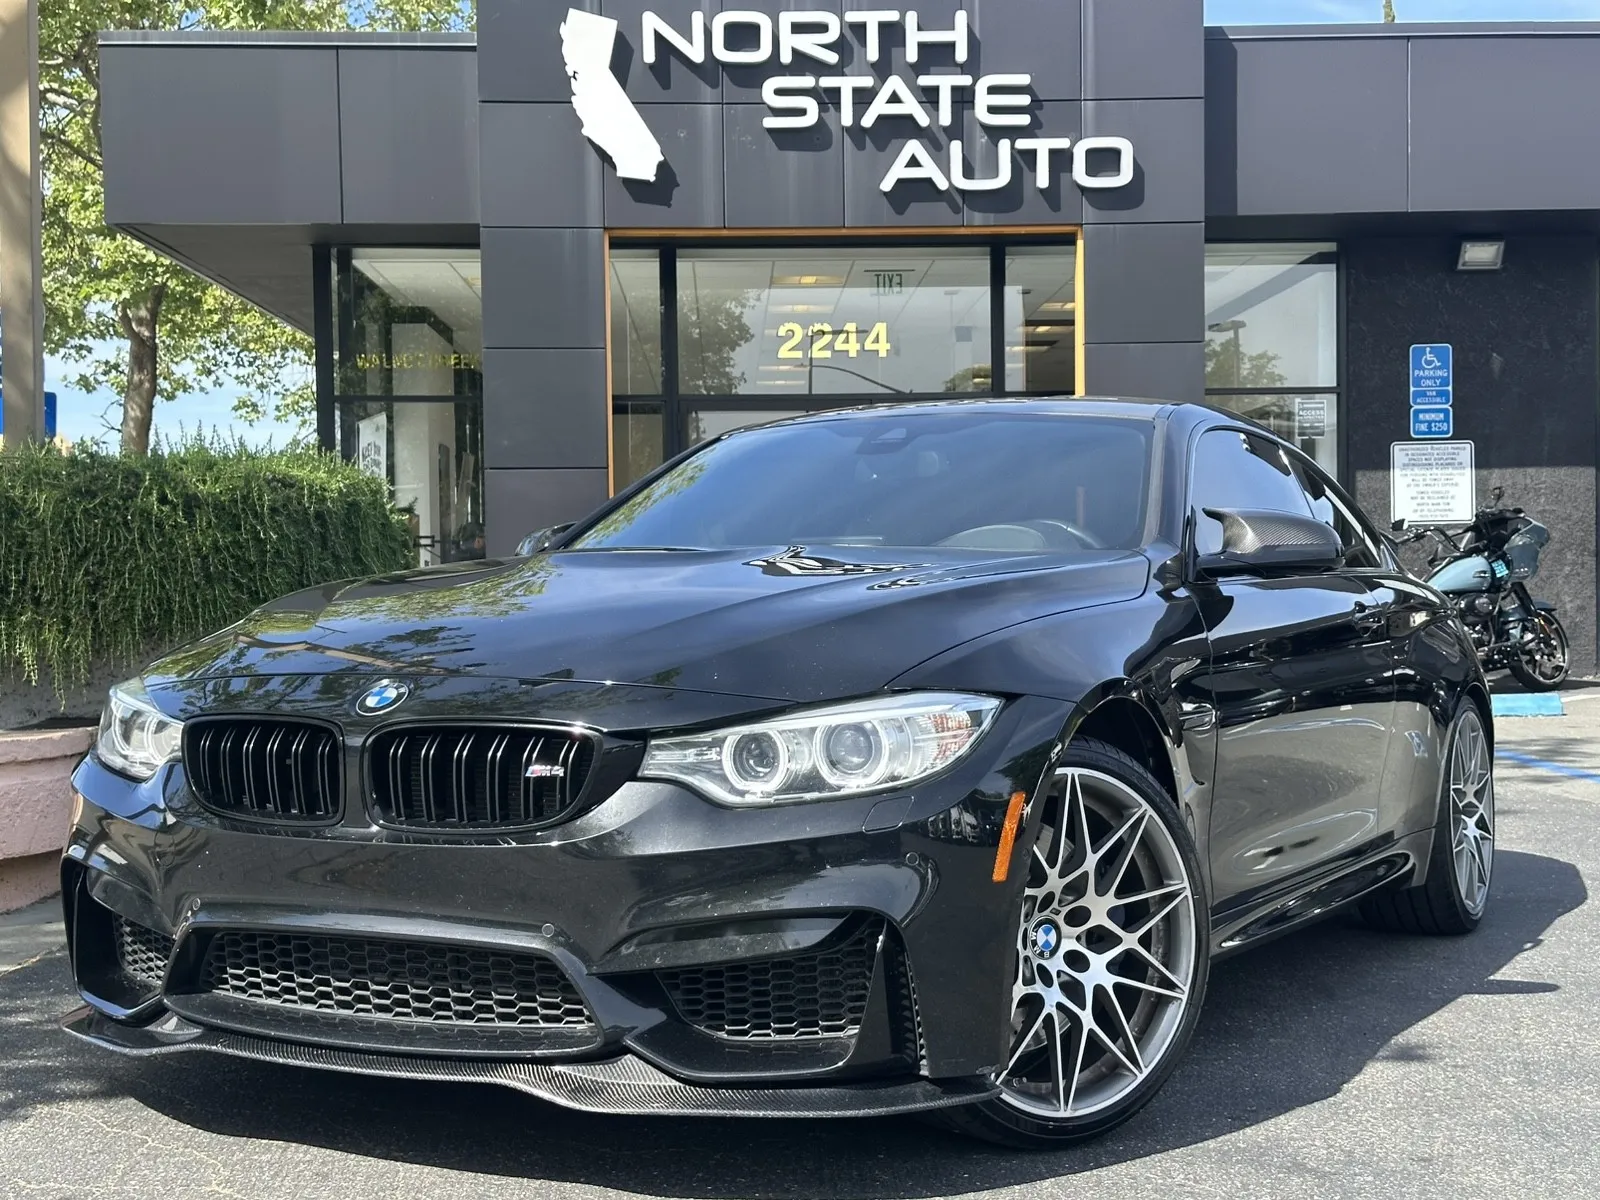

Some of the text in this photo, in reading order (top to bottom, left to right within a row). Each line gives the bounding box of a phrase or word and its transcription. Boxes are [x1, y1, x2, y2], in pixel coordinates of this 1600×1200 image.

[641, 9, 968, 65] NORTH
[761, 73, 1032, 129] STATE
[879, 136, 1135, 192] AUTO
[776, 322, 891, 360] 2244
[1414, 369, 1448, 377] PARKING
[1420, 378, 1441, 387] ONLY
[1415, 422, 1448, 432] FINE $250
[1418, 412, 1445, 421] MINIMUM
